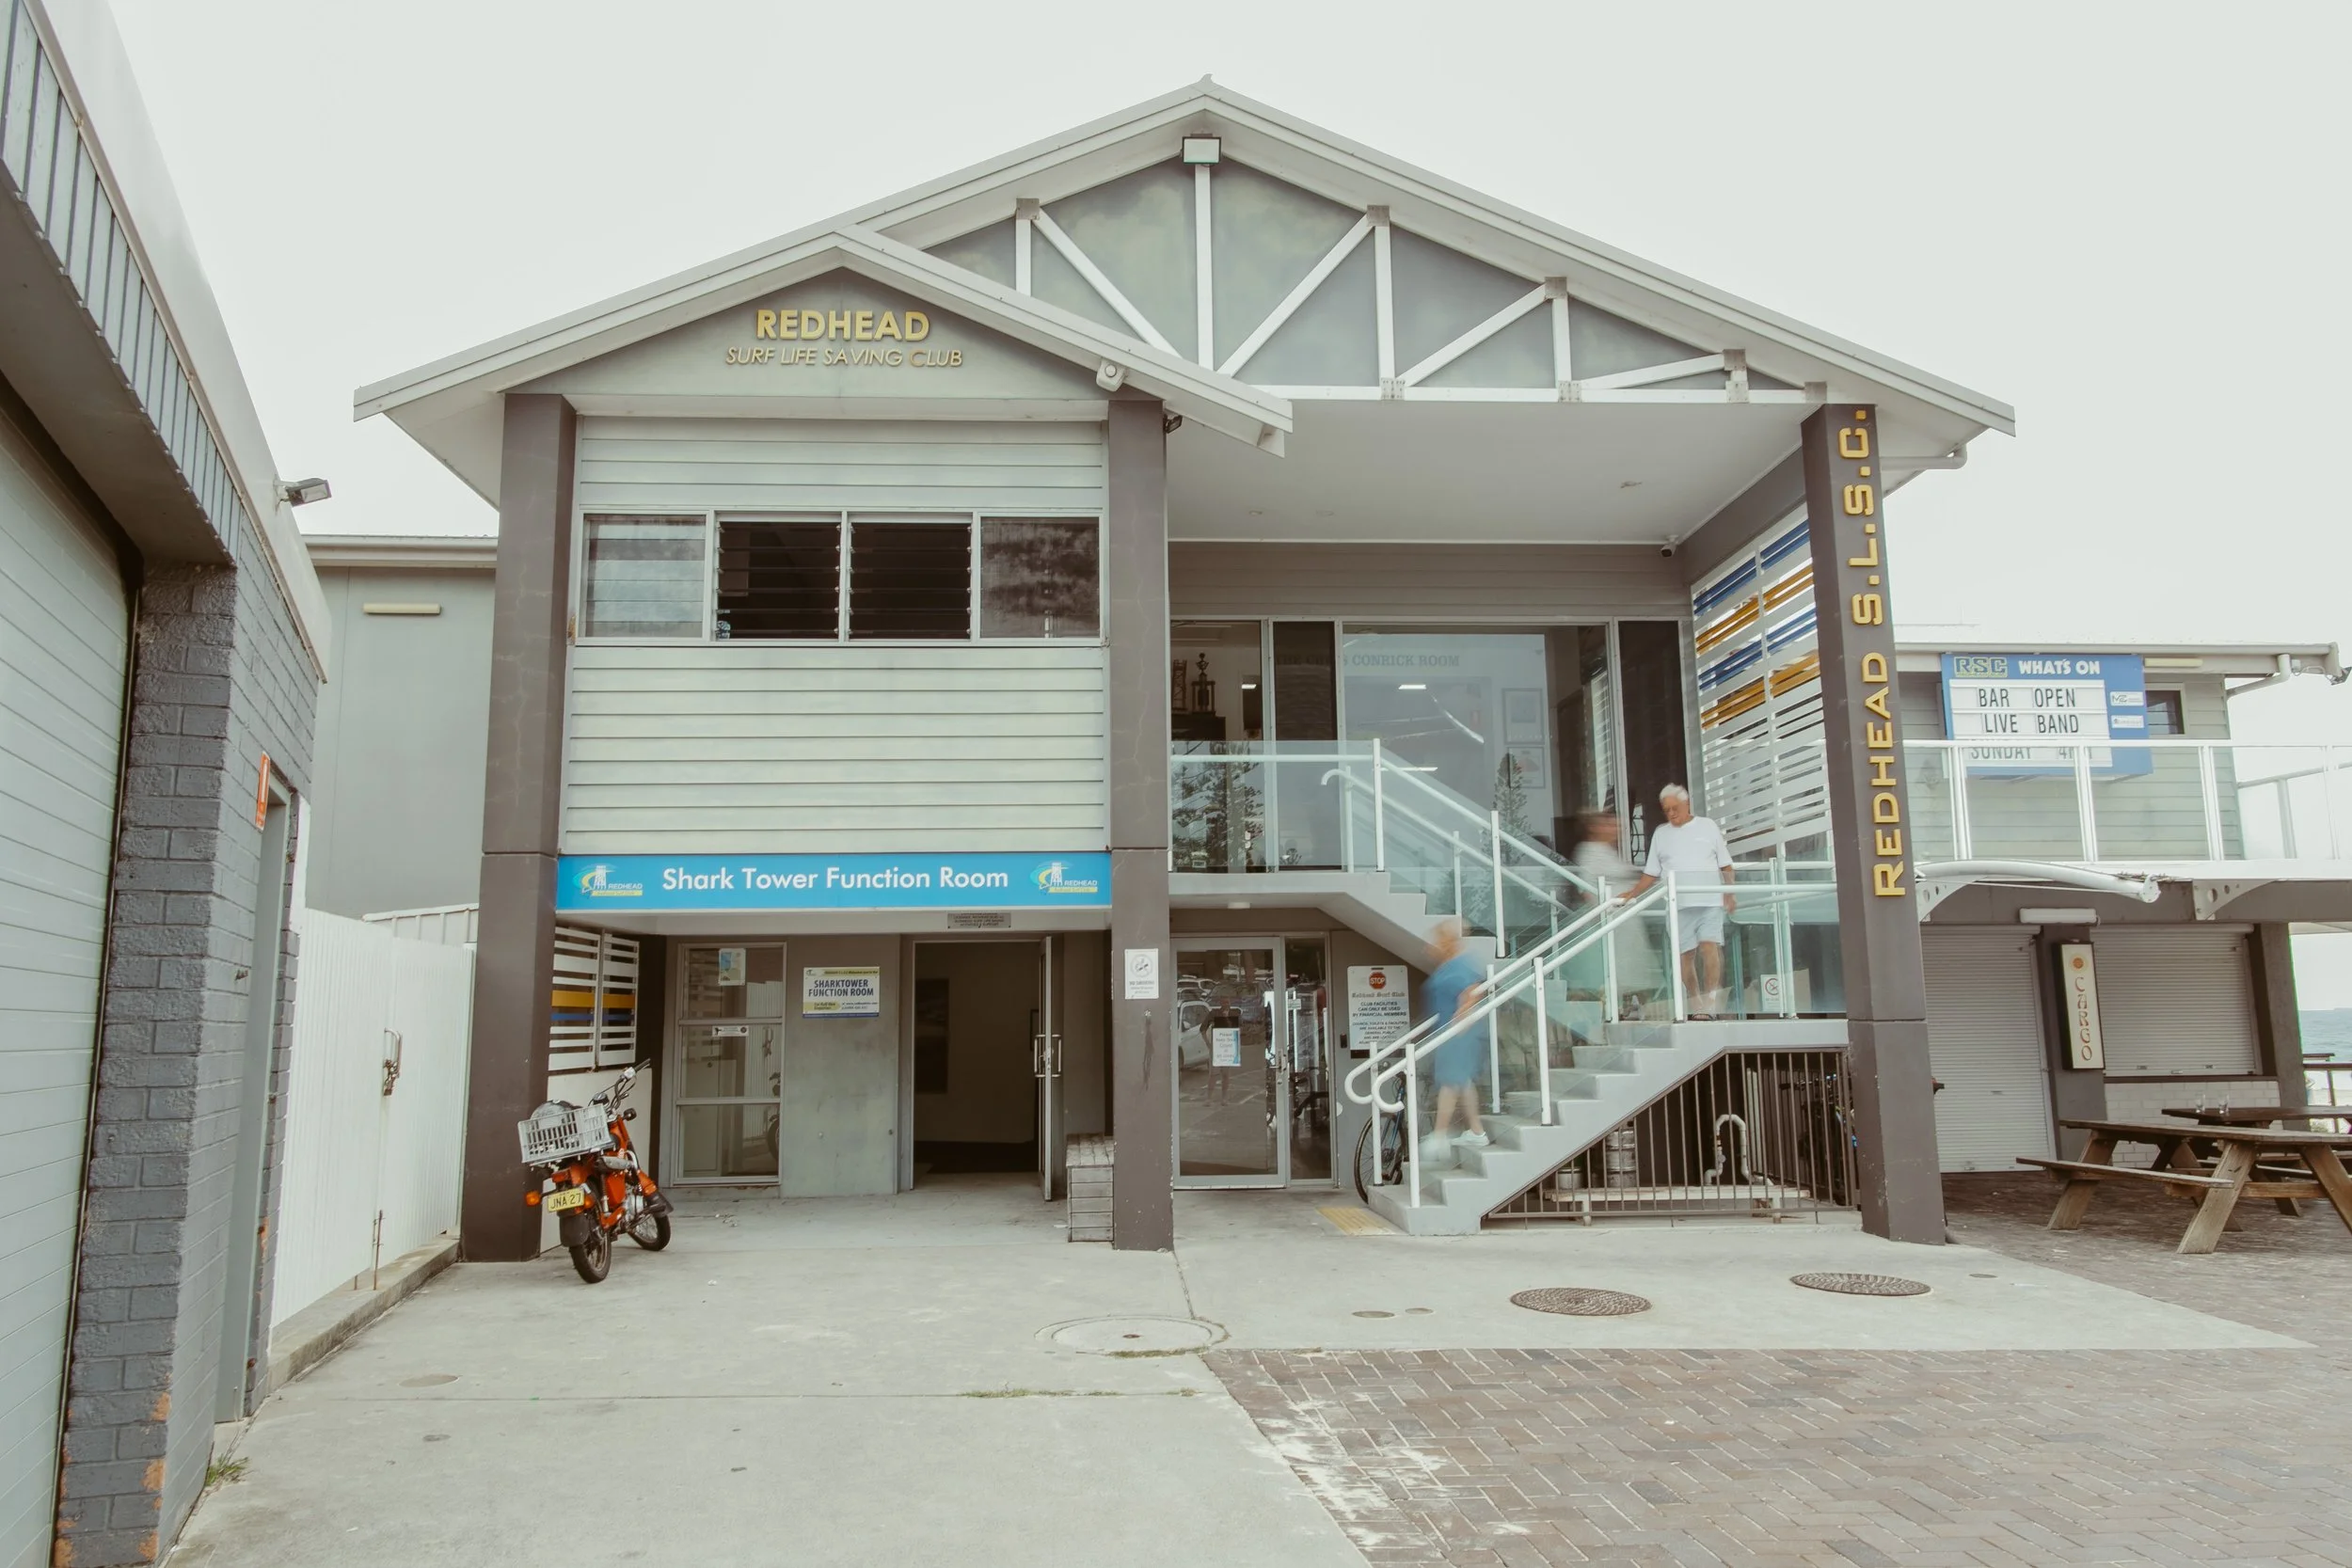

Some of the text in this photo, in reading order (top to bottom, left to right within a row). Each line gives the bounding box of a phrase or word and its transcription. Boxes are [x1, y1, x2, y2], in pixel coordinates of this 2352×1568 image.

[756, 309, 930, 341] REDHEAD
[725, 345, 963, 367] SURF LIFE SAVING CLUB
[1352, 654, 1414, 667] CONRICK
[1418, 654, 1460, 667] ROOM
[1838, 409, 1906, 896] REDHEAD S.L.S.C.
[1954, 657, 2008, 674] RSC
[2018, 658, 2101, 675] WHAT'S ON
[1979, 688, 2075, 707] BAR OPEN
[1983, 713, 2079, 734] LIVE BAND
[1970, 742, 2031, 760] SUNDAY
[662, 866, 1009, 890] Shark Tower Function Room
[808, 988, 874, 997] FUNCTION ROOM
[814, 979, 868, 989] SHARKTOWER
[2074, 976, 2093, 1061] CARGO
[550, 1192, 581, 1210] JNA 27
